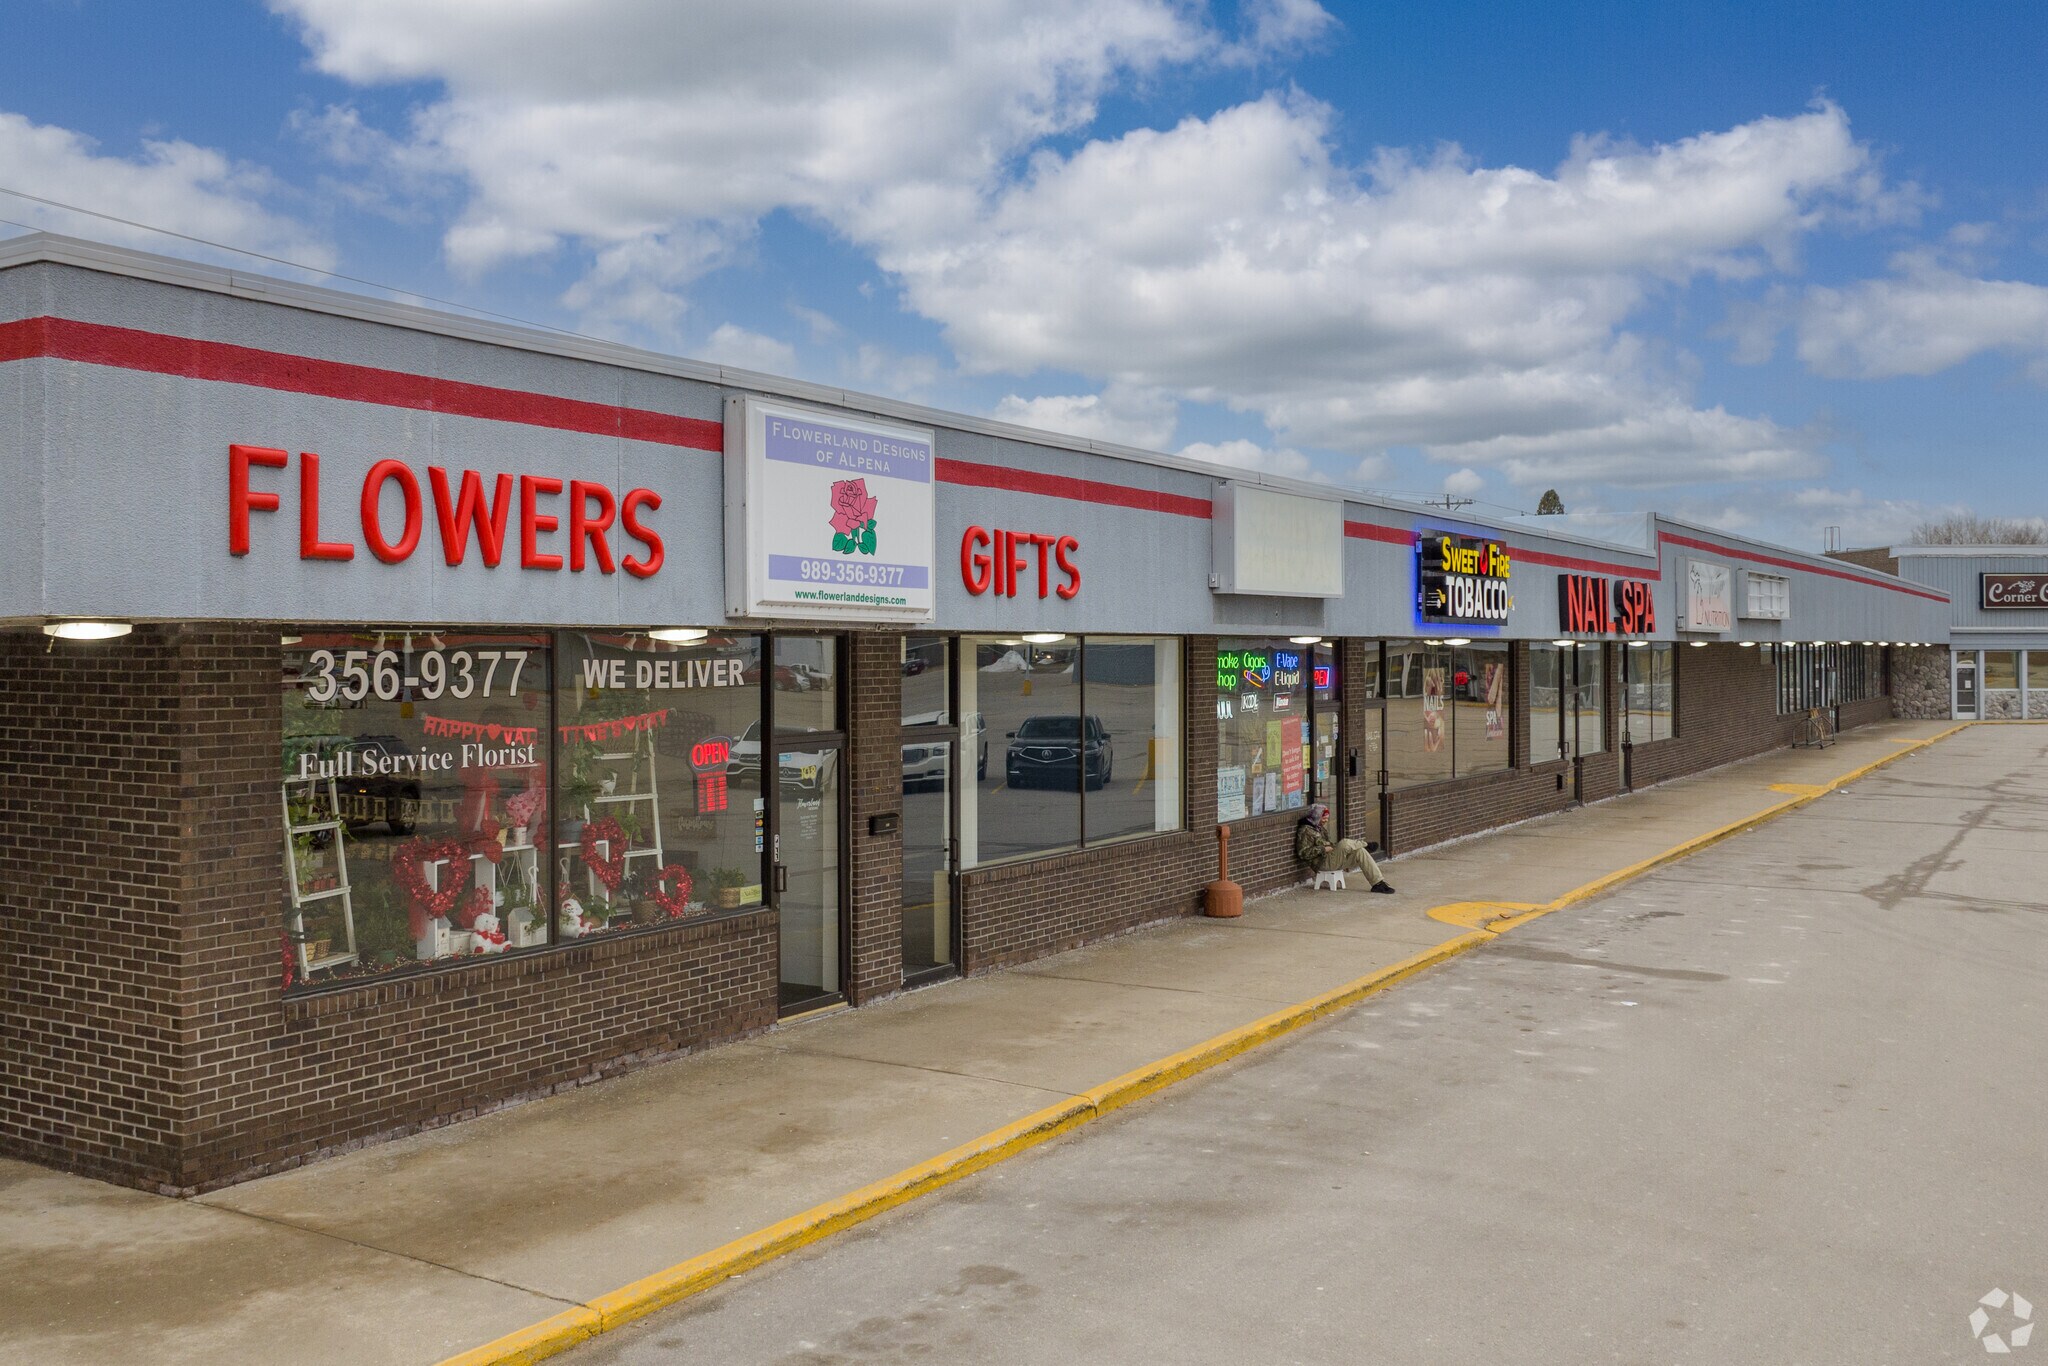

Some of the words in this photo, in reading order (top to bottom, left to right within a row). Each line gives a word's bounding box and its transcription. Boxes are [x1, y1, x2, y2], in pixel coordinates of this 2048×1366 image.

[772, 421, 868, 452] FLOWERLAND
[873, 440, 926, 462] DESIGNS
[838, 452, 891, 473] ALPENA
[229, 444, 666, 580] FLOWERS
[961, 525, 1082, 600] GIFTS
[1442, 536, 1480, 574] SWEET
[801, 560, 904, 585] 989-356-9377
[795, 590, 907, 606] www.flowerlanddesigns.com
[1446, 576, 1508, 619] TOBACCO
[1564, 574, 1617, 633] NAIL
[1620, 580, 1656, 635] SPA
[1989, 583, 2038, 603] Corner
[1217, 652, 1239, 669] moke
[1243, 652, 1265, 672] Cigars
[1276, 652, 1298, 670] E-Vape
[309, 649, 528, 702] 356-9377
[583, 658, 626, 689] WE
[636, 658, 745, 689] DELIVER
[1217, 671, 1237, 690] hop
[1274, 671, 1300, 688] E-Liquid
[1423, 695, 1444, 711] NAILS
[423, 715, 488, 743] HAPPY
[1486, 711, 1498, 725] SPA
[299, 752, 353, 780] Full
[361, 746, 453, 776] Service
[461, 740, 536, 768] Florist
[691, 742, 729, 767] OPEN
